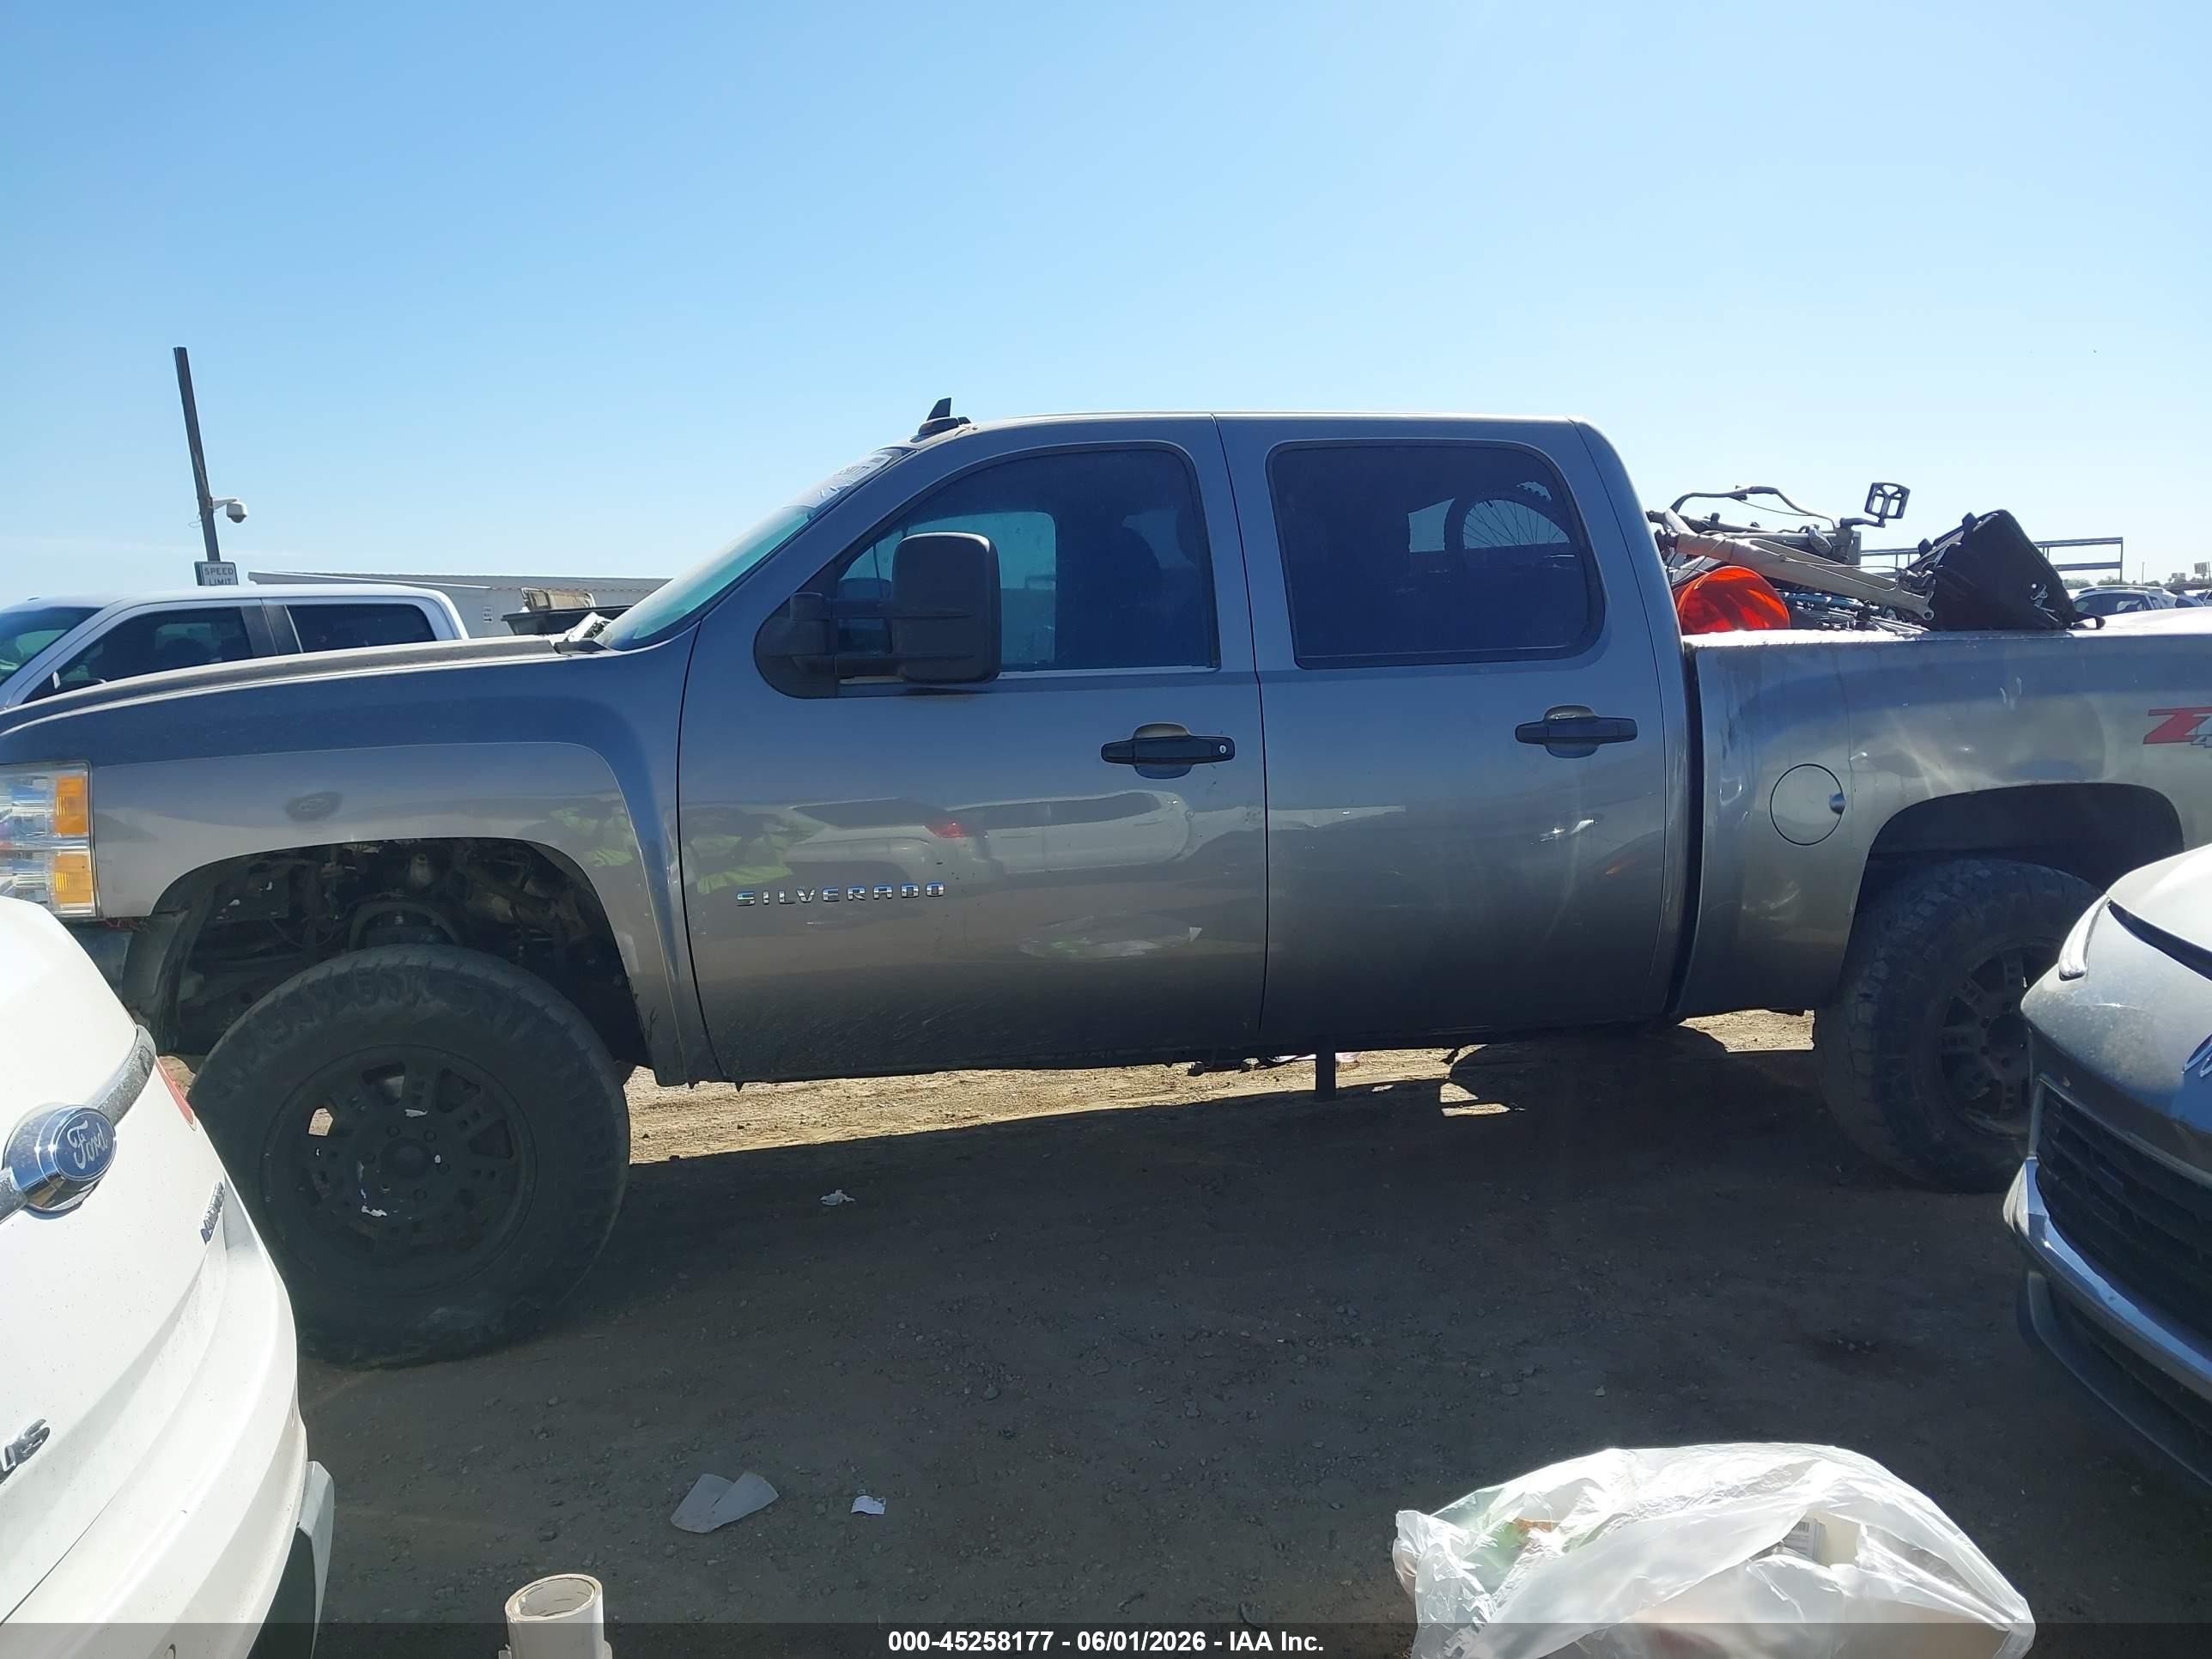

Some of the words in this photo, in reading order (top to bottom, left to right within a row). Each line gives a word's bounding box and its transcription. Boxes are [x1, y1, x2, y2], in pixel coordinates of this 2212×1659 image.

[204, 567, 234, 575] SPEED
[736, 881, 945, 907] SILVERADO
[66, 1119, 109, 1170] Ford
